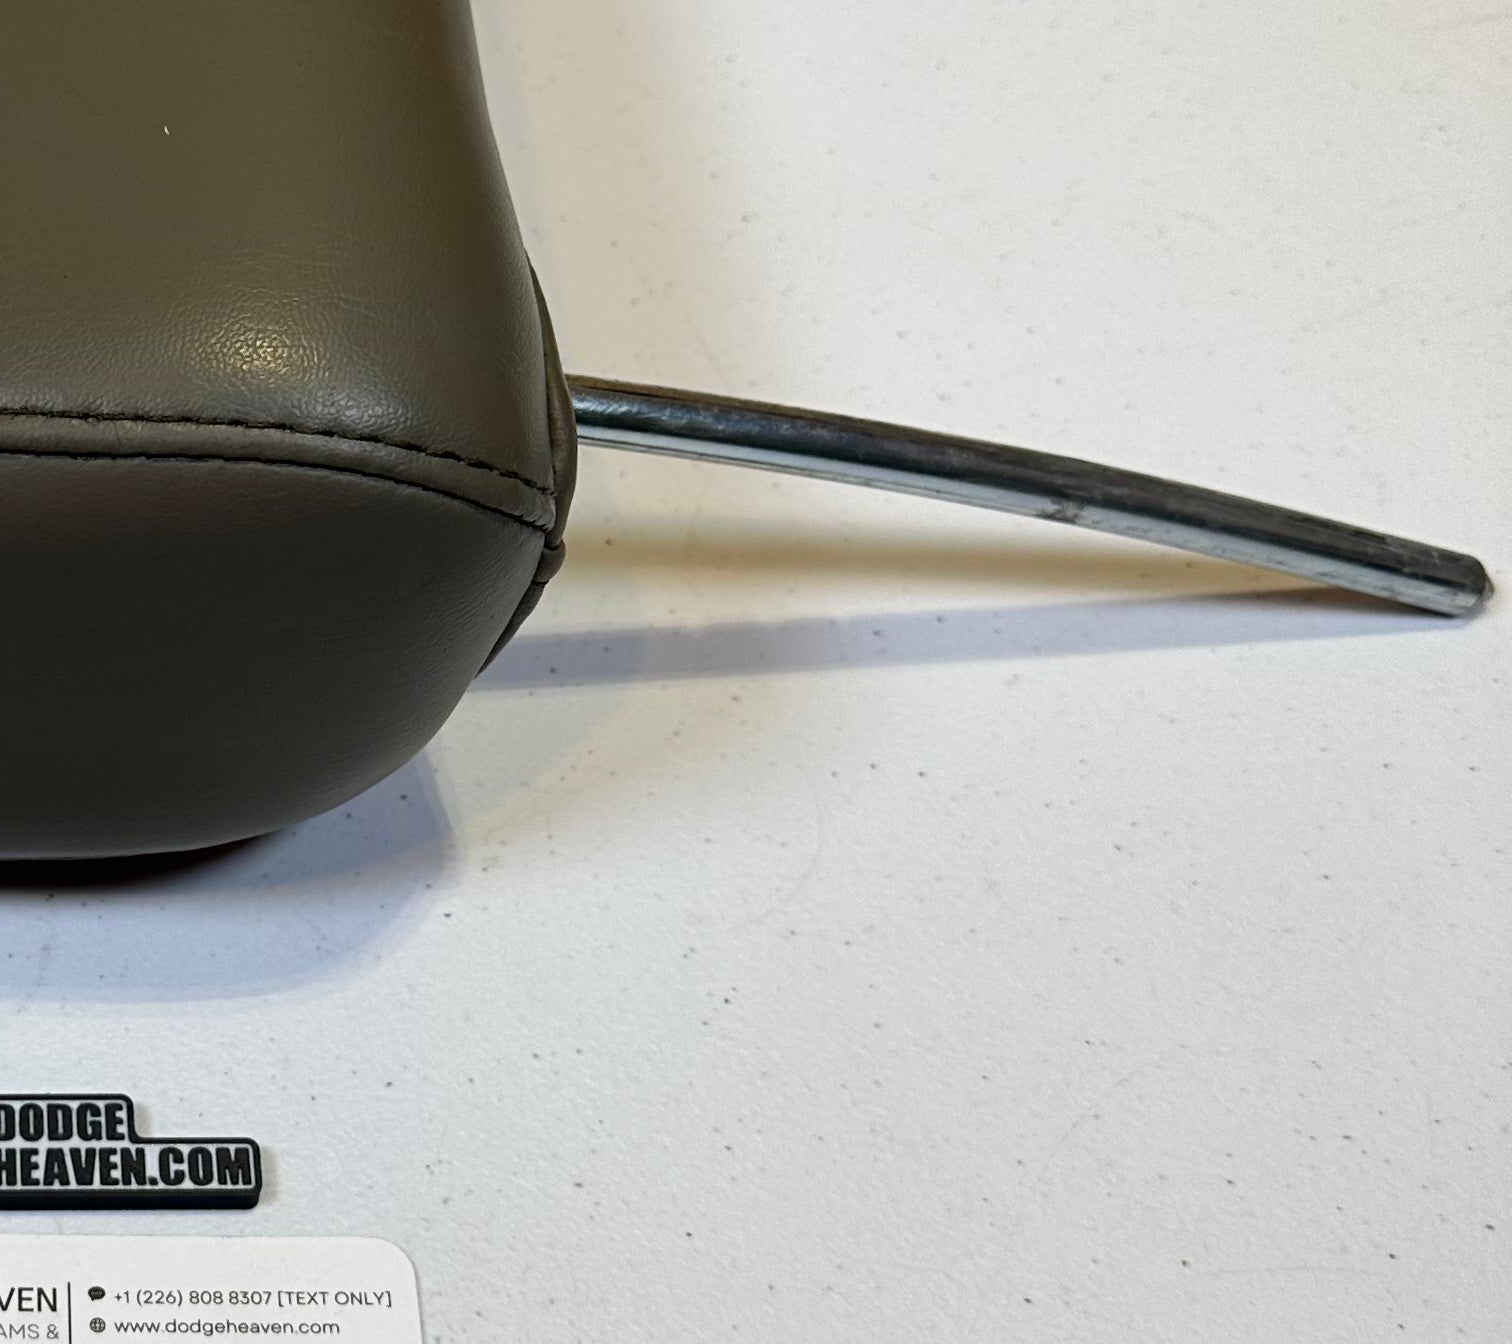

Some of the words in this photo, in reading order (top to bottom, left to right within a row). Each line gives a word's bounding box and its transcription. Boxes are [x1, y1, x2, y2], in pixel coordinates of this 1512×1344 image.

[114, 1291, 129, 1303] +1
[137, 1289, 183, 1307] (226)
[189, 1291, 223, 1305] 808
[229, 1291, 271, 1305] 8307
[278, 1291, 329, 1307] [TEXT
[335, 1291, 392, 1308] ONLY]
[47, 1324, 59, 1339] &
[114, 1319, 340, 1336] www.dodgeheaven.com
